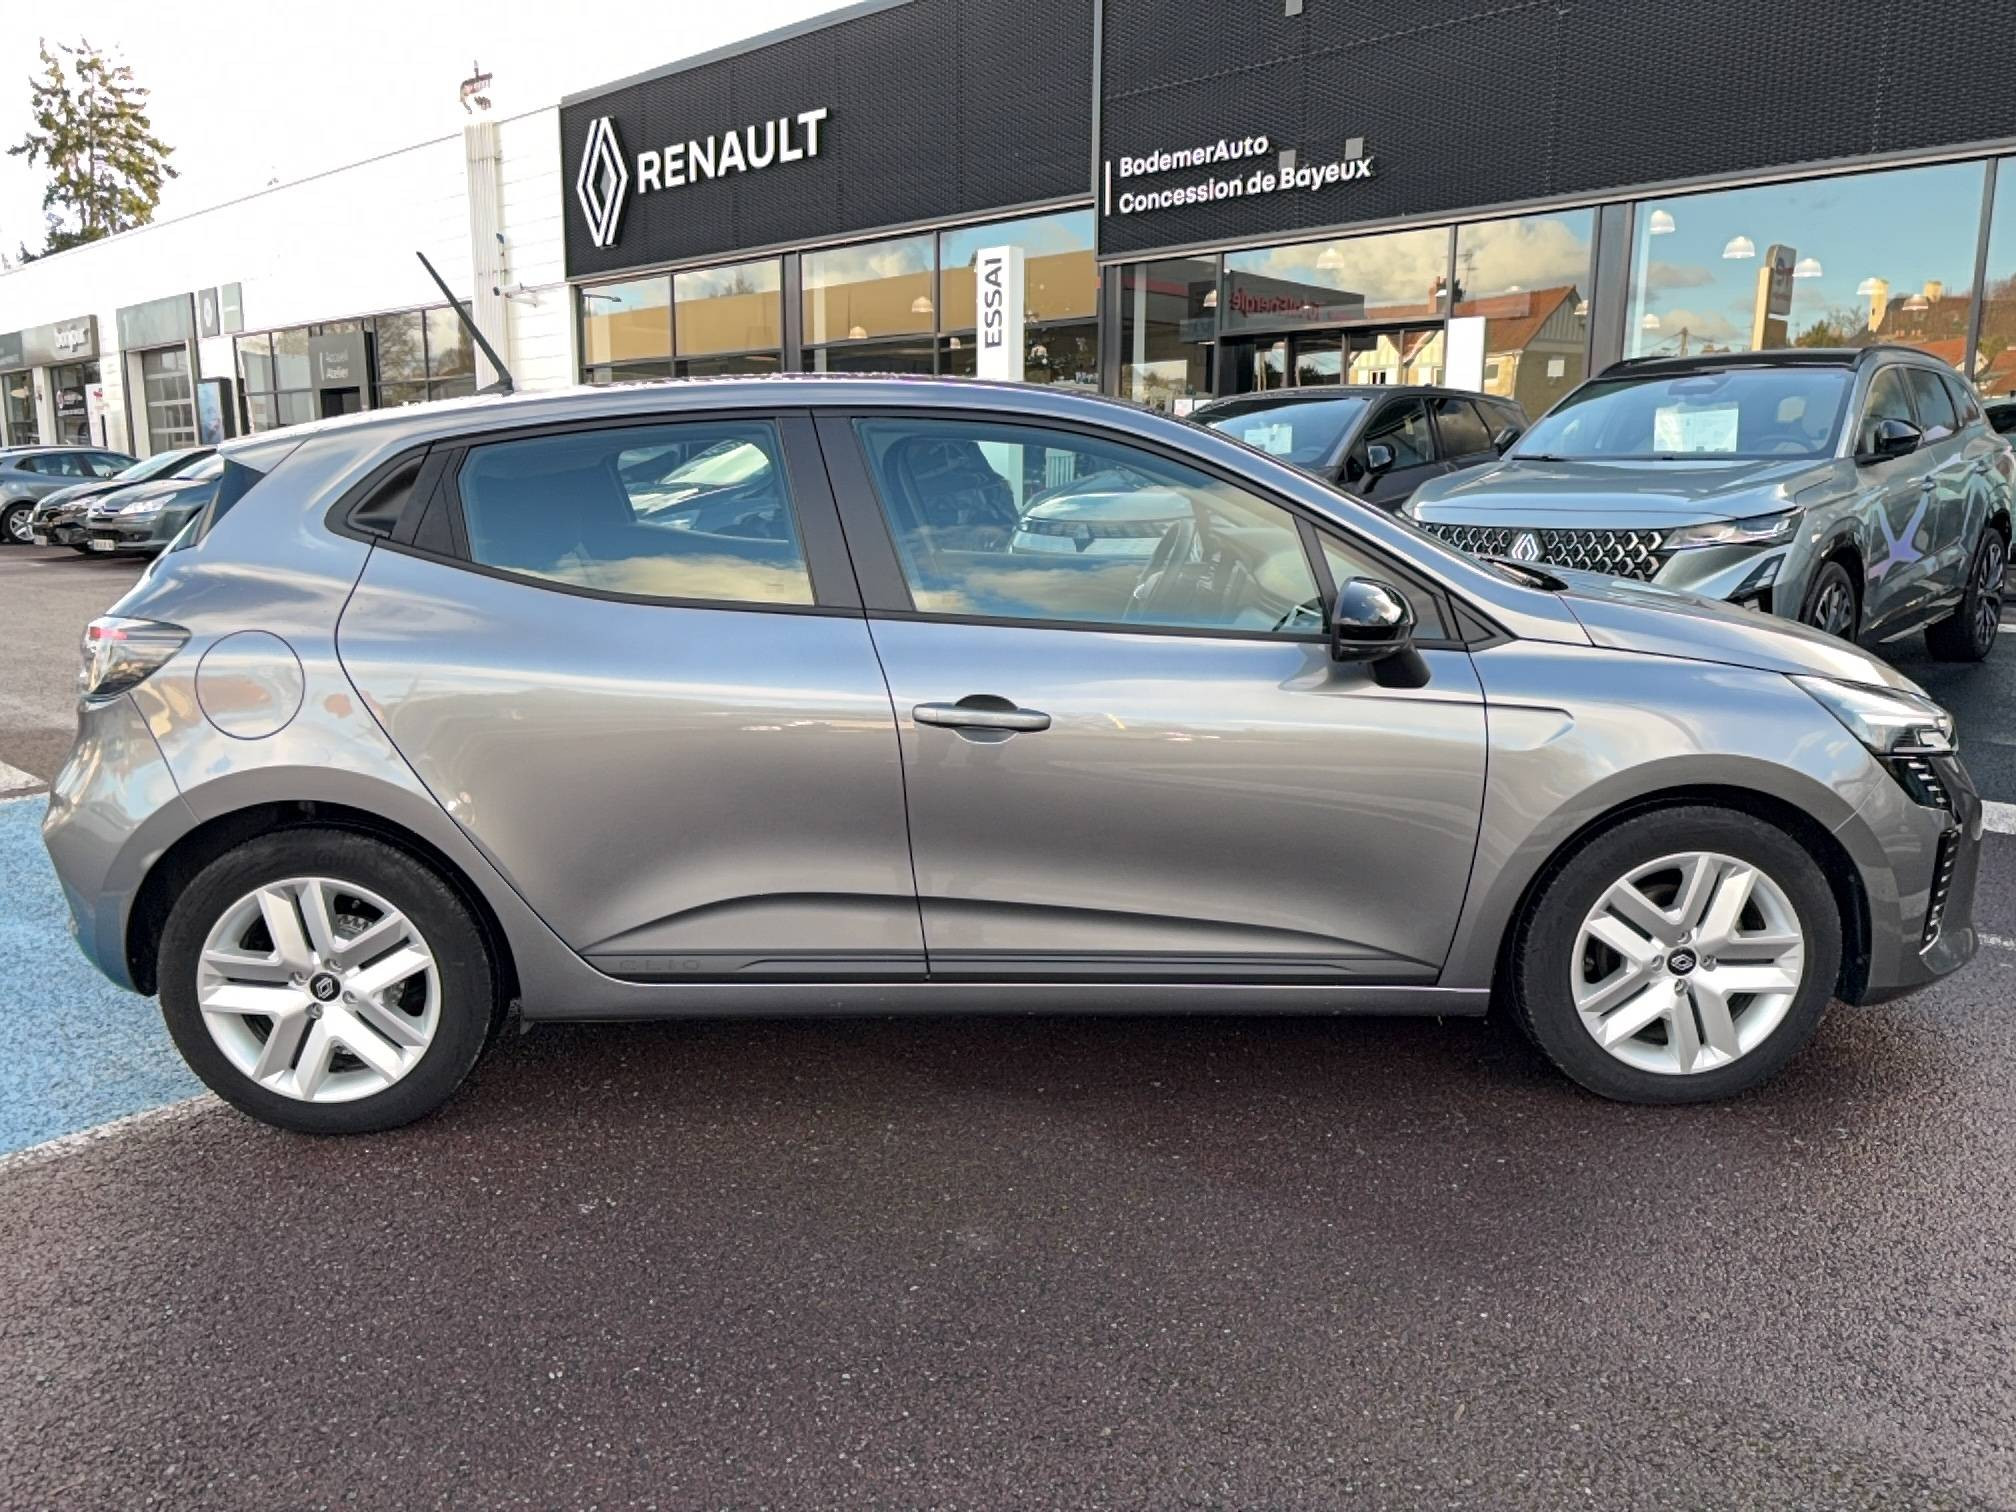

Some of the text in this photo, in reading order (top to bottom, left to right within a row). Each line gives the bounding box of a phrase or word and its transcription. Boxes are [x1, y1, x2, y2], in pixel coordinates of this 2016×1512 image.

[637, 107, 827, 194] RENAULT
[1119, 135, 1269, 177] BodemerAuto
[1119, 157, 1371, 214] Concession de Bayeux
[984, 258, 1002, 348] ESSAI
